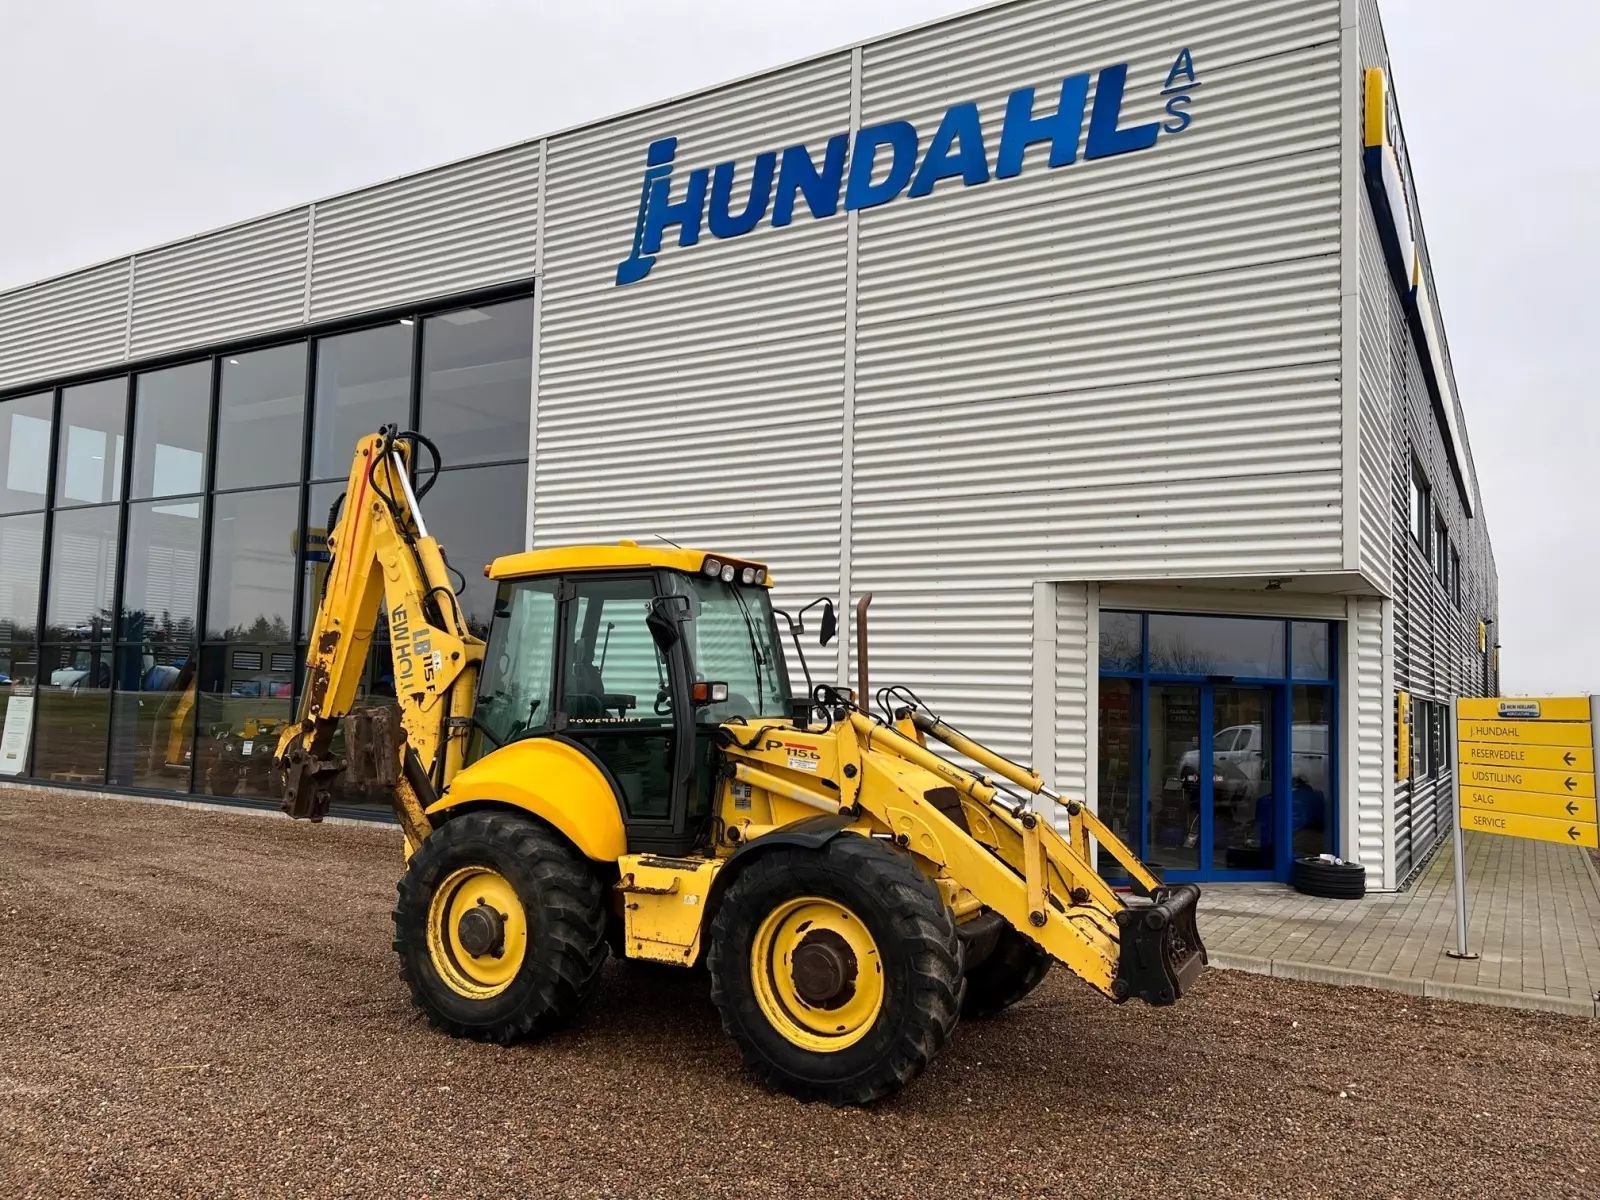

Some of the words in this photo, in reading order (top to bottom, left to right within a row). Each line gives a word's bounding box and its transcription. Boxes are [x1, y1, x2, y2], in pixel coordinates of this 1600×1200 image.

[1476, 726, 1520, 737] HUNDAHL
[1471, 748, 1525, 760] RESERVEDELE
[1472, 771, 1522, 784] UDSTILLING
[1472, 793, 1494, 804] SALG
[1473, 815, 1506, 828] SERVICE
